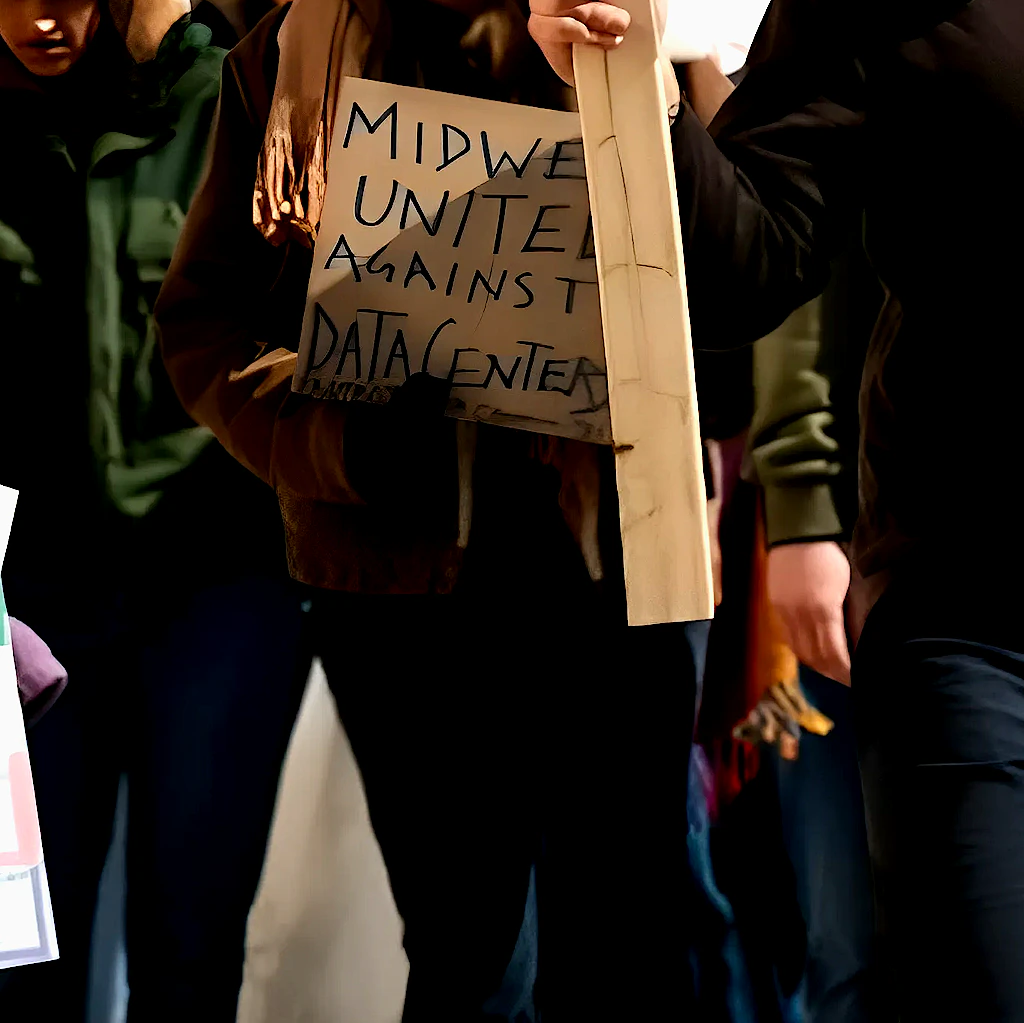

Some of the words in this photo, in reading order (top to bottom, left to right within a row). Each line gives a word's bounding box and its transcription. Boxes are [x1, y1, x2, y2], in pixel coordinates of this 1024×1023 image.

[343, 101, 587, 180] MIDWE
[324, 233, 600, 314] AGAINST
[306, 302, 411, 378] DATA
